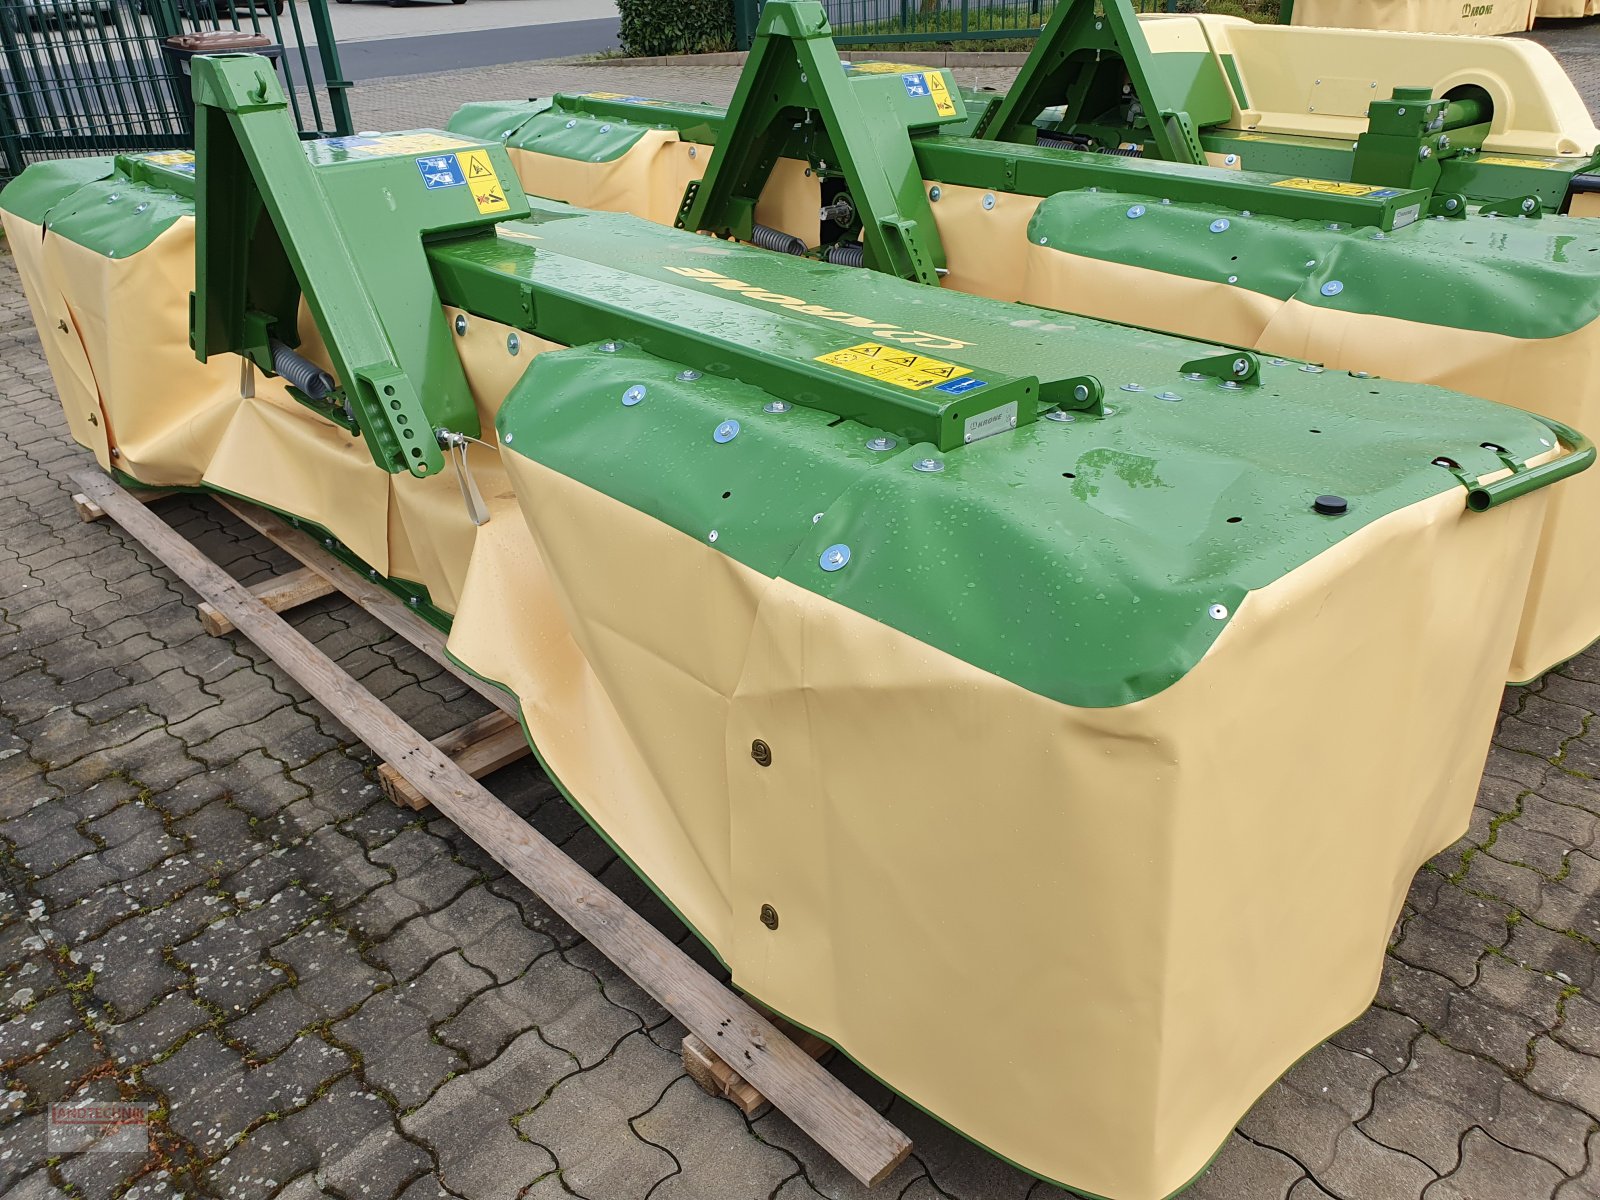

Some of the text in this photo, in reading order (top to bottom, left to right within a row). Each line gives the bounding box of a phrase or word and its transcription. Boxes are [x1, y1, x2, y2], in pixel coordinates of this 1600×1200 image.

[1470, 4, 1494, 17] KRONE
[661, 265, 902, 329] KRONE
[977, 413, 1003, 429] KRONE
